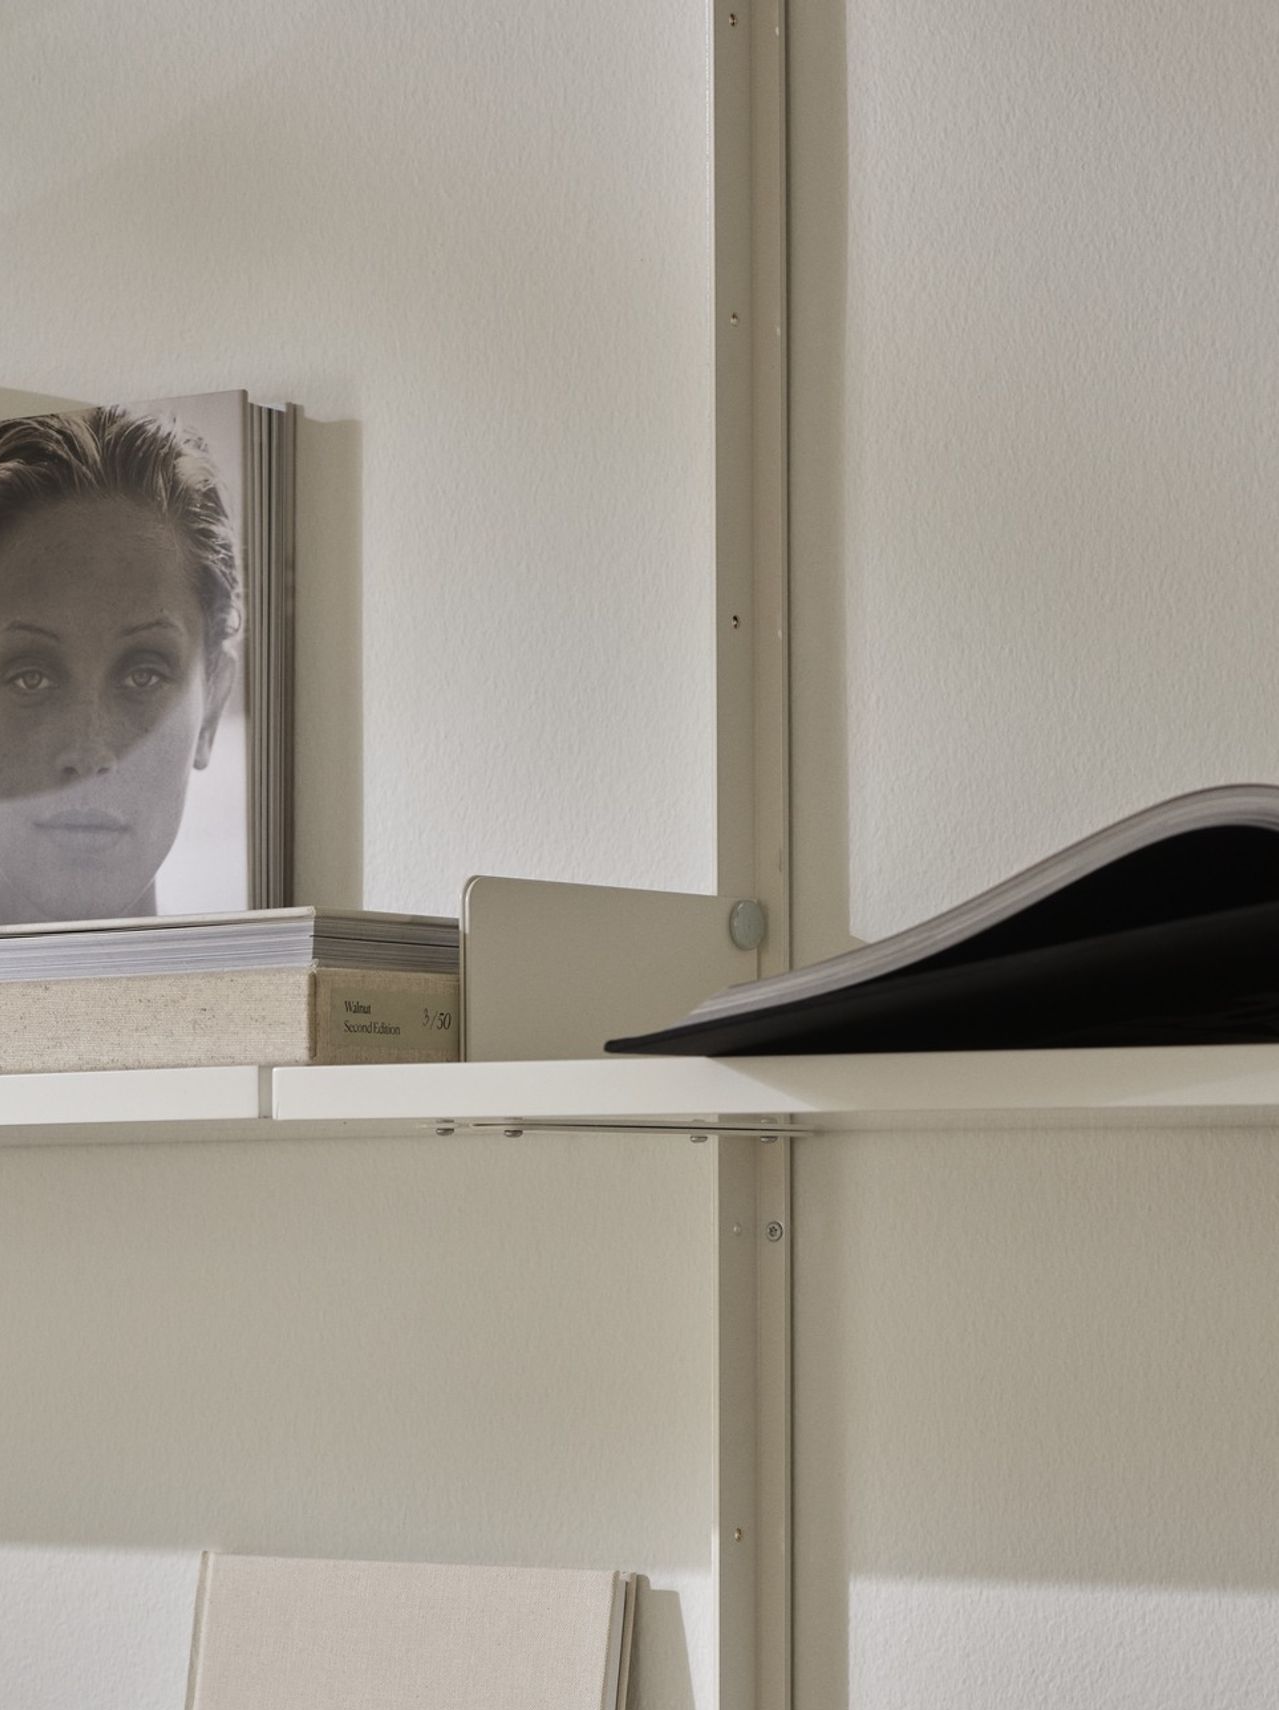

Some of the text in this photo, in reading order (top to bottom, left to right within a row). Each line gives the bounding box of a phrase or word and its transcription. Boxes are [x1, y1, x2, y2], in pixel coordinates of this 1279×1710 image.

[343, 1000, 372, 1015] Walnut
[343, 1020, 401, 1036] Second Edition
